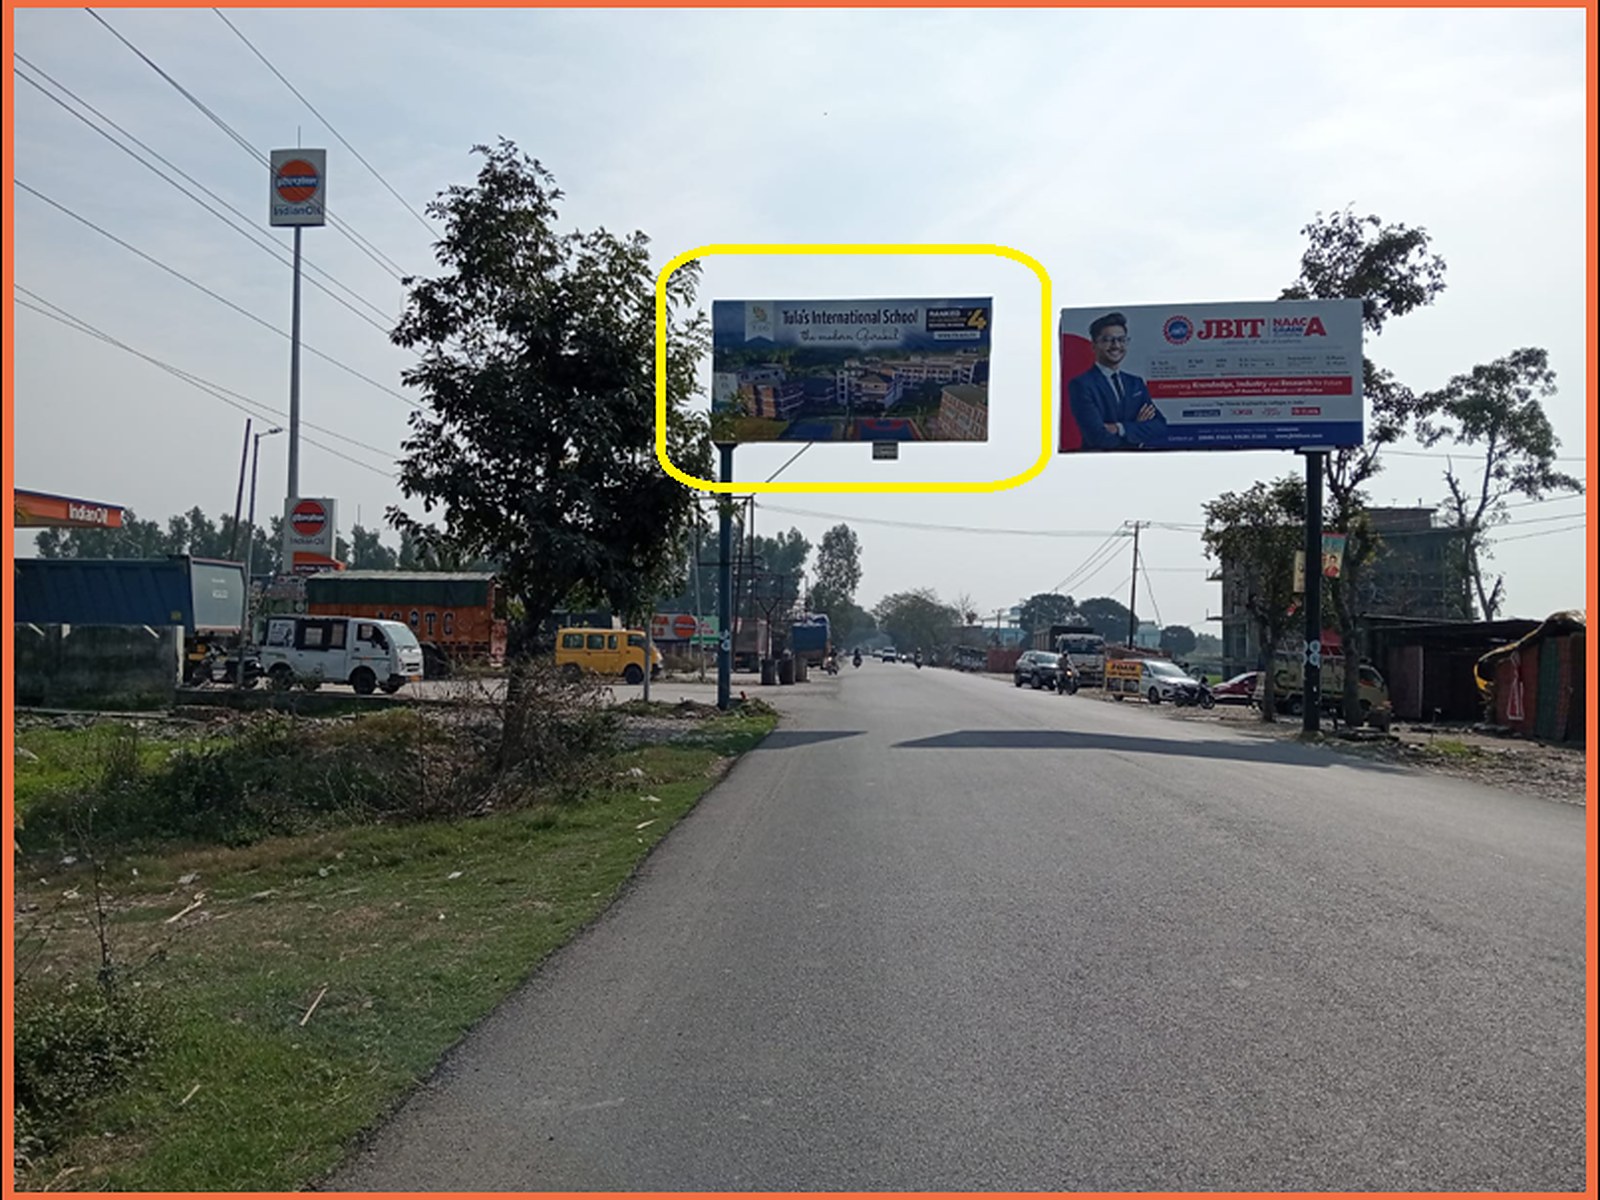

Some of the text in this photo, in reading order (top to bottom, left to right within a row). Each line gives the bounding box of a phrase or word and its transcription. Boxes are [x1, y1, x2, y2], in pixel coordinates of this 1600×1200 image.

[782, 308, 919, 325] Tula's International School
[1272, 316, 1307, 327] NAAC
[1196, 318, 1265, 340] JBIT
[1303, 315, 1328, 338] A
[1236, 379, 1268, 389] Industry
[68, 503, 108, 524] IndianOil
